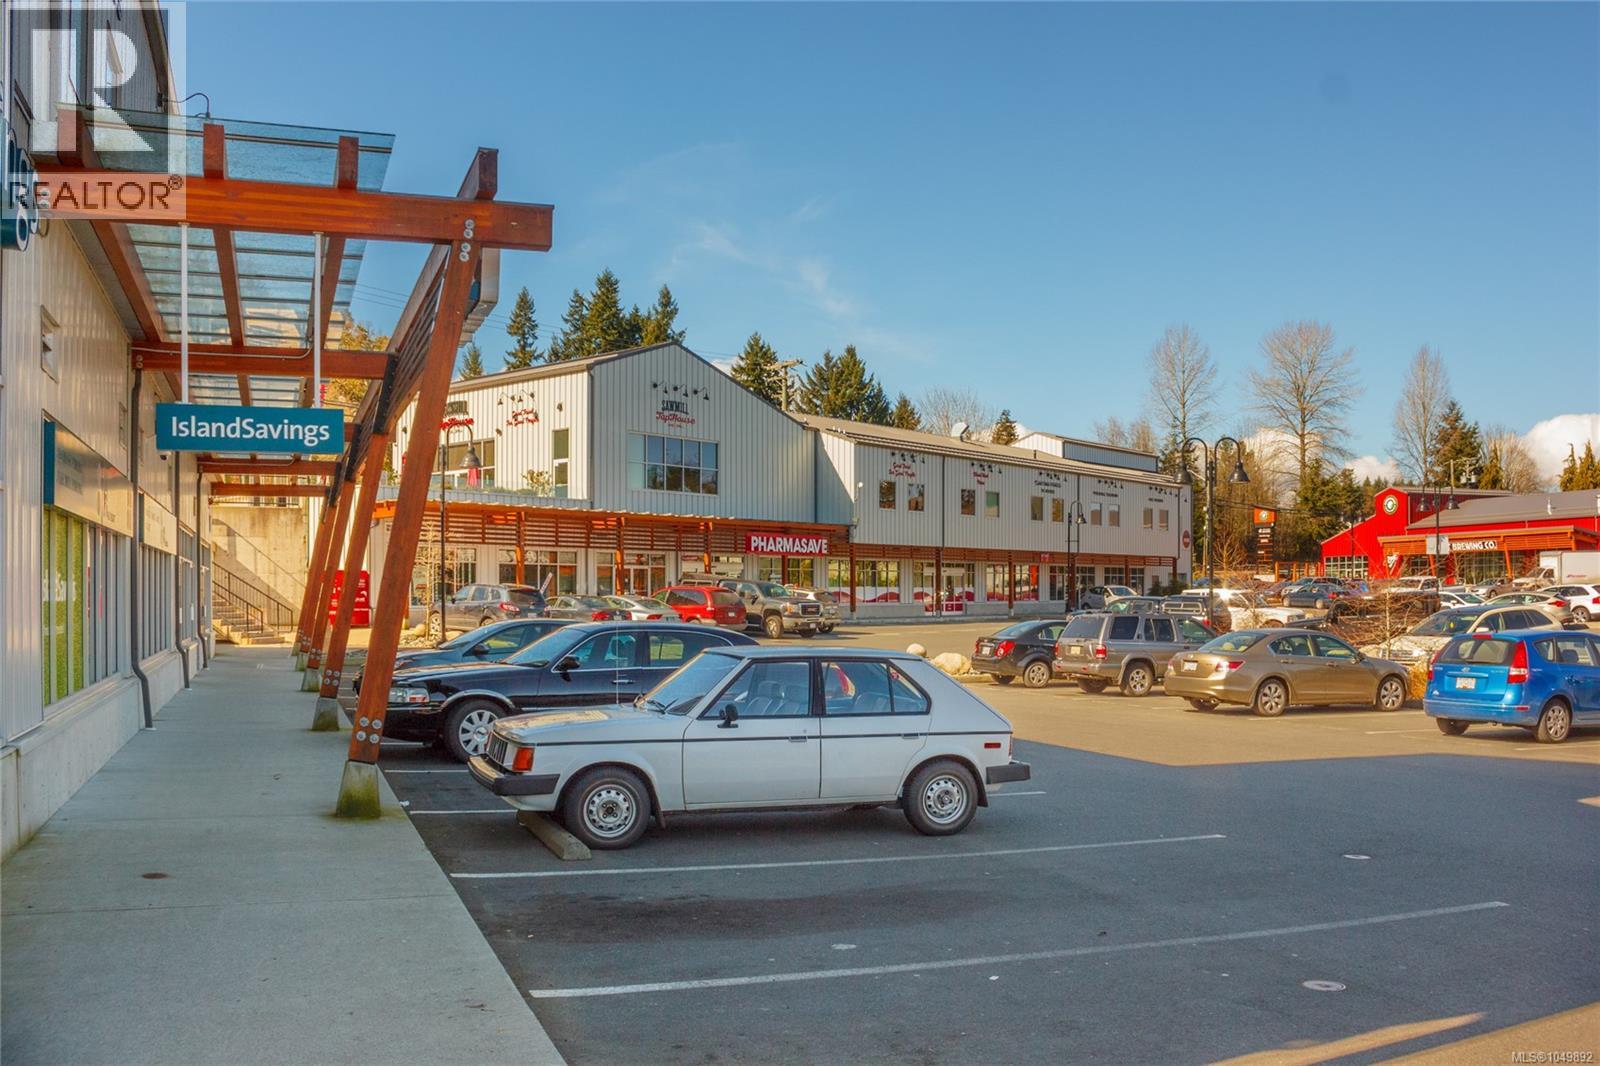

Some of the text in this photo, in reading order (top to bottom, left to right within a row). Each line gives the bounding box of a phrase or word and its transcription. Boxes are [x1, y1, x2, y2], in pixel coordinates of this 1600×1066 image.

[661, 400, 689, 415] SAWMILL
[172, 416, 330, 447] IslandSavings
[751, 535, 828, 554] PHARMASAVE
[1452, 541, 1483, 551] BREWING
